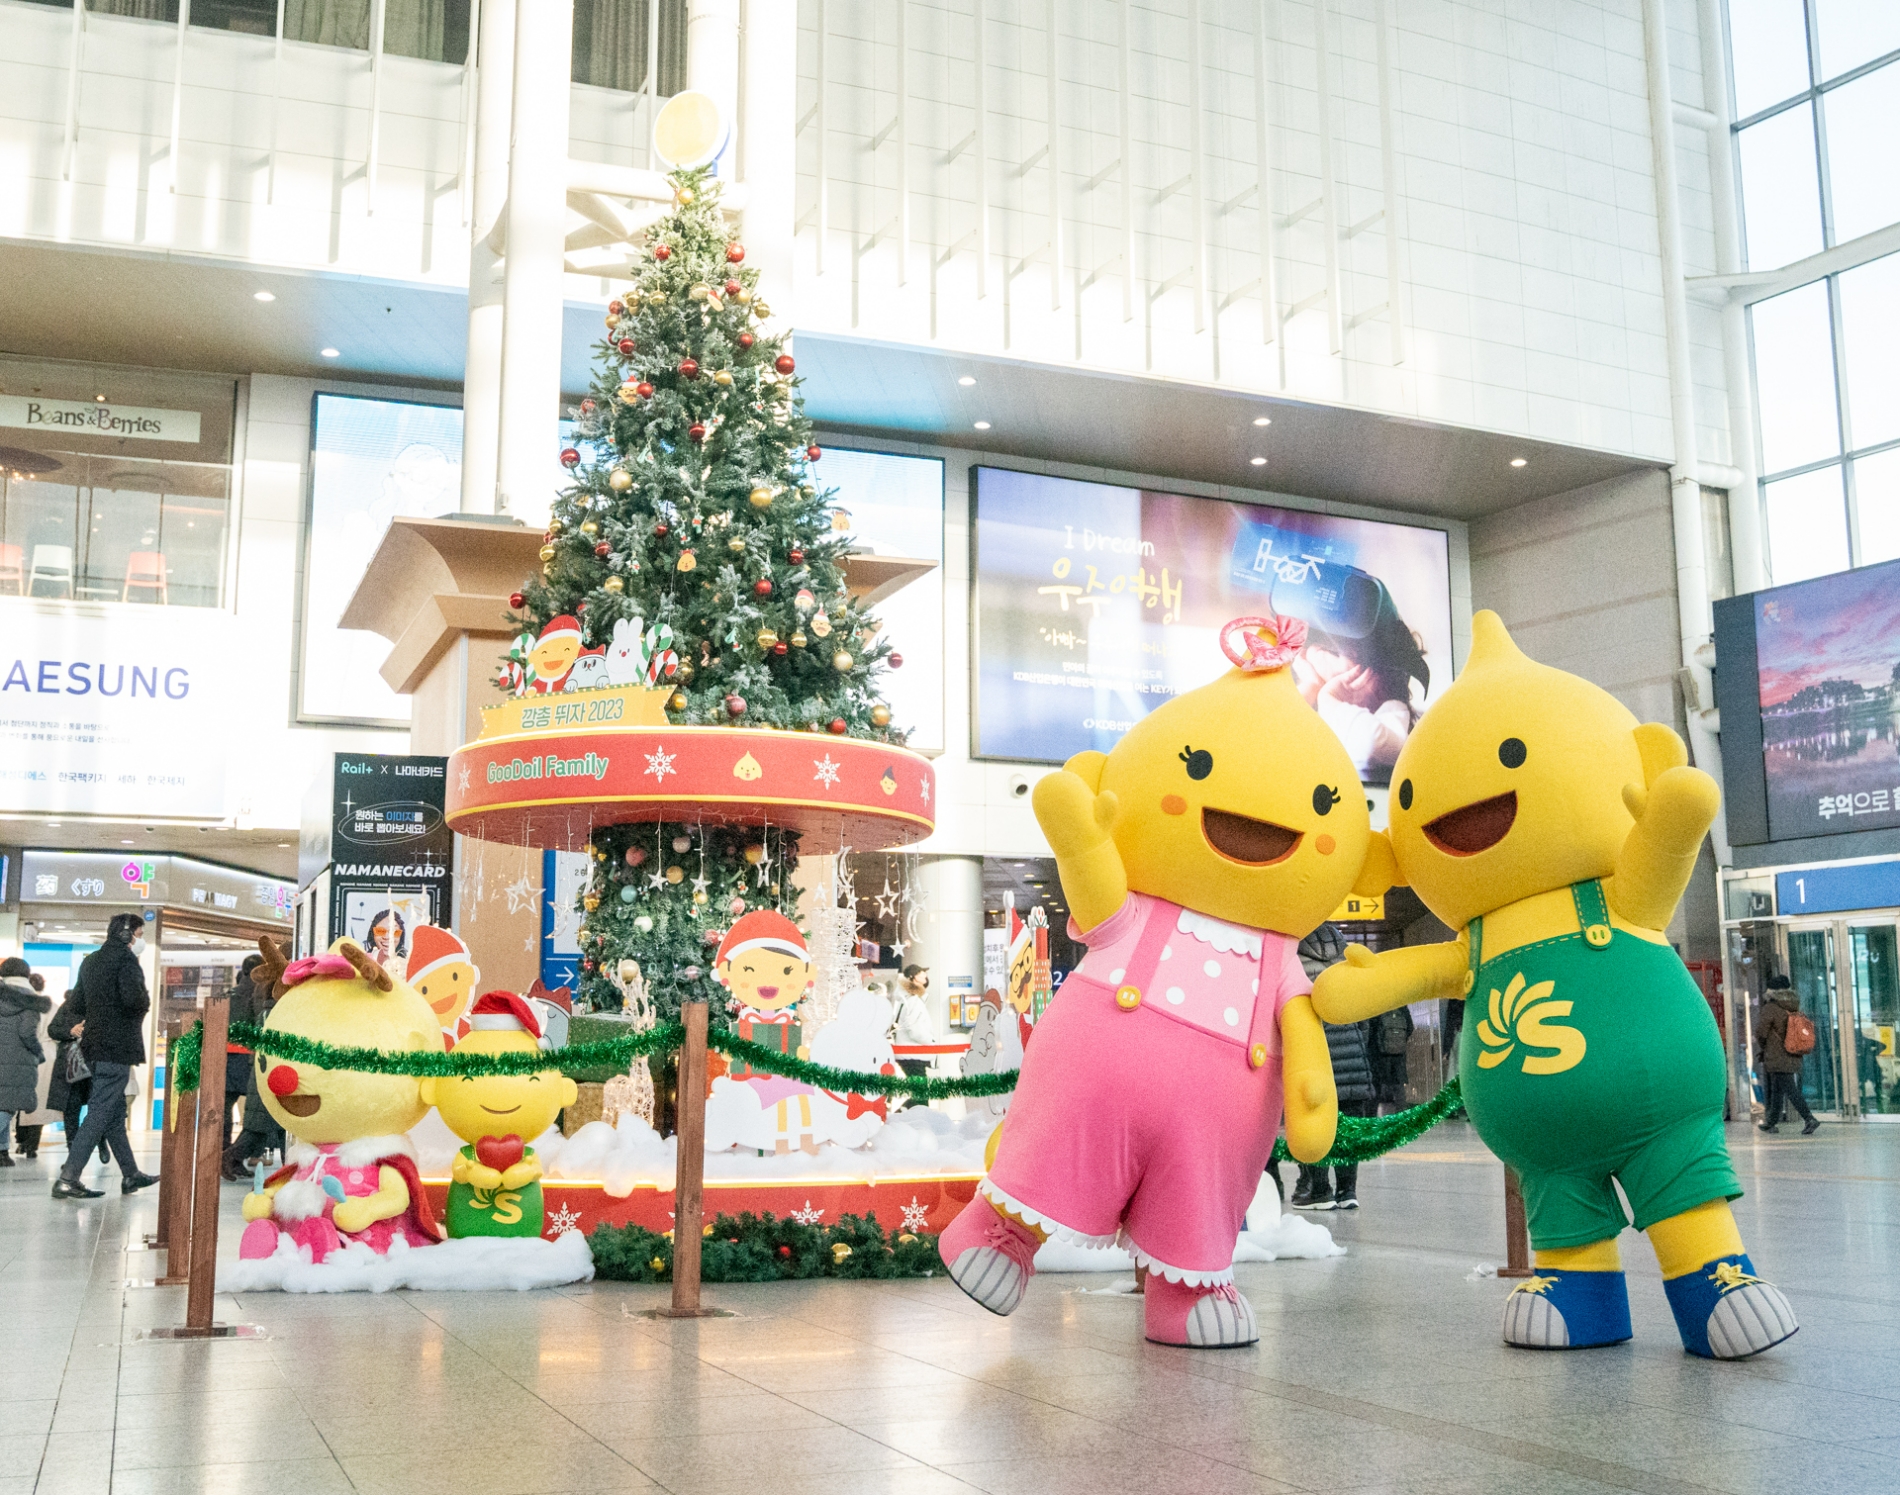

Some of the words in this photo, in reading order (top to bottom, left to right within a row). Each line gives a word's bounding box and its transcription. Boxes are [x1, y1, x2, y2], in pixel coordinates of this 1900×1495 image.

[1063, 525, 1075, 550] I
[1083, 528, 1156, 557] Dream
[2, 659, 190, 700] AESUNG
[587, 700, 624, 722] 2023
[395, 765, 444, 777] 나마네카드
[545, 751, 609, 783] Family
[1818, 789, 1891, 820] 추억으로
[355, 809, 384, 821] 원하는
[386, 811, 424, 823] 이미지를
[354, 822, 374, 833] 바로
[121, 862, 155, 898] 약
[335, 864, 446, 878] NAMANECARD
[71, 878, 104, 896] くすり
[1796, 878, 1806, 905] 1
[1053, 970, 1063, 986] 2
